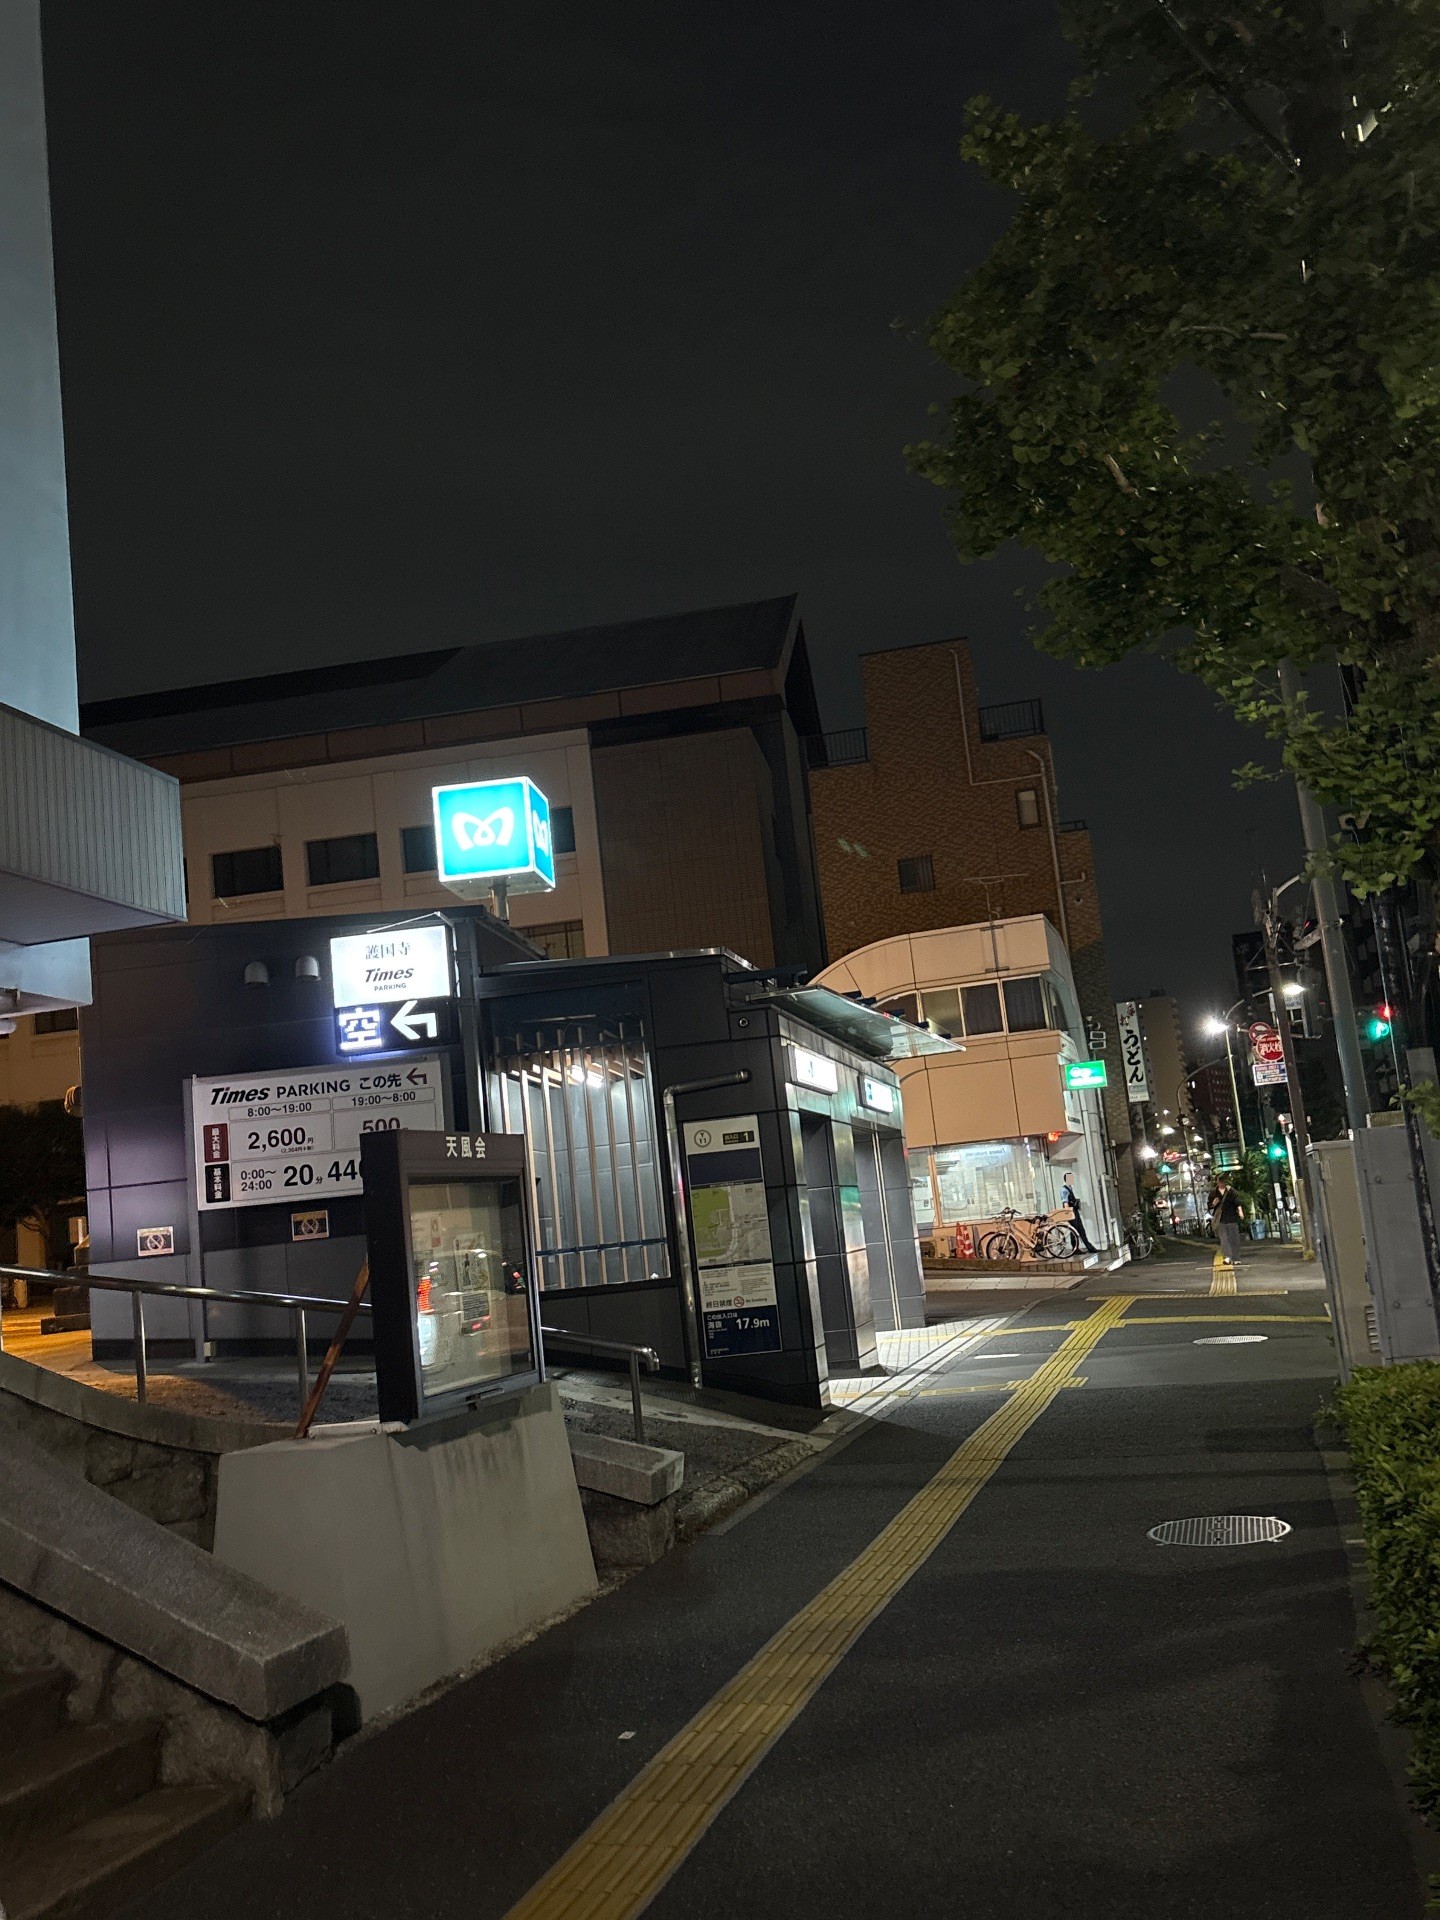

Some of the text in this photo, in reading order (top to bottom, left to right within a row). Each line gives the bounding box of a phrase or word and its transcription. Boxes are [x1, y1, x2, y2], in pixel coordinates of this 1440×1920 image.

[365, 967, 414, 982] Times
[374, 982, 406, 991] PARKING
[339, 1007, 383, 1050] 空
[1123, 1029, 1144, 1084] うどん
[210, 1073, 402, 1105] Times PARKING この先
[743, 1132, 749, 1142] 1
[445, 1136, 486, 1159] 天風会
[240, 1179, 272, 1192] 24:00
[736, 1317, 770, 1330] 17.9m
